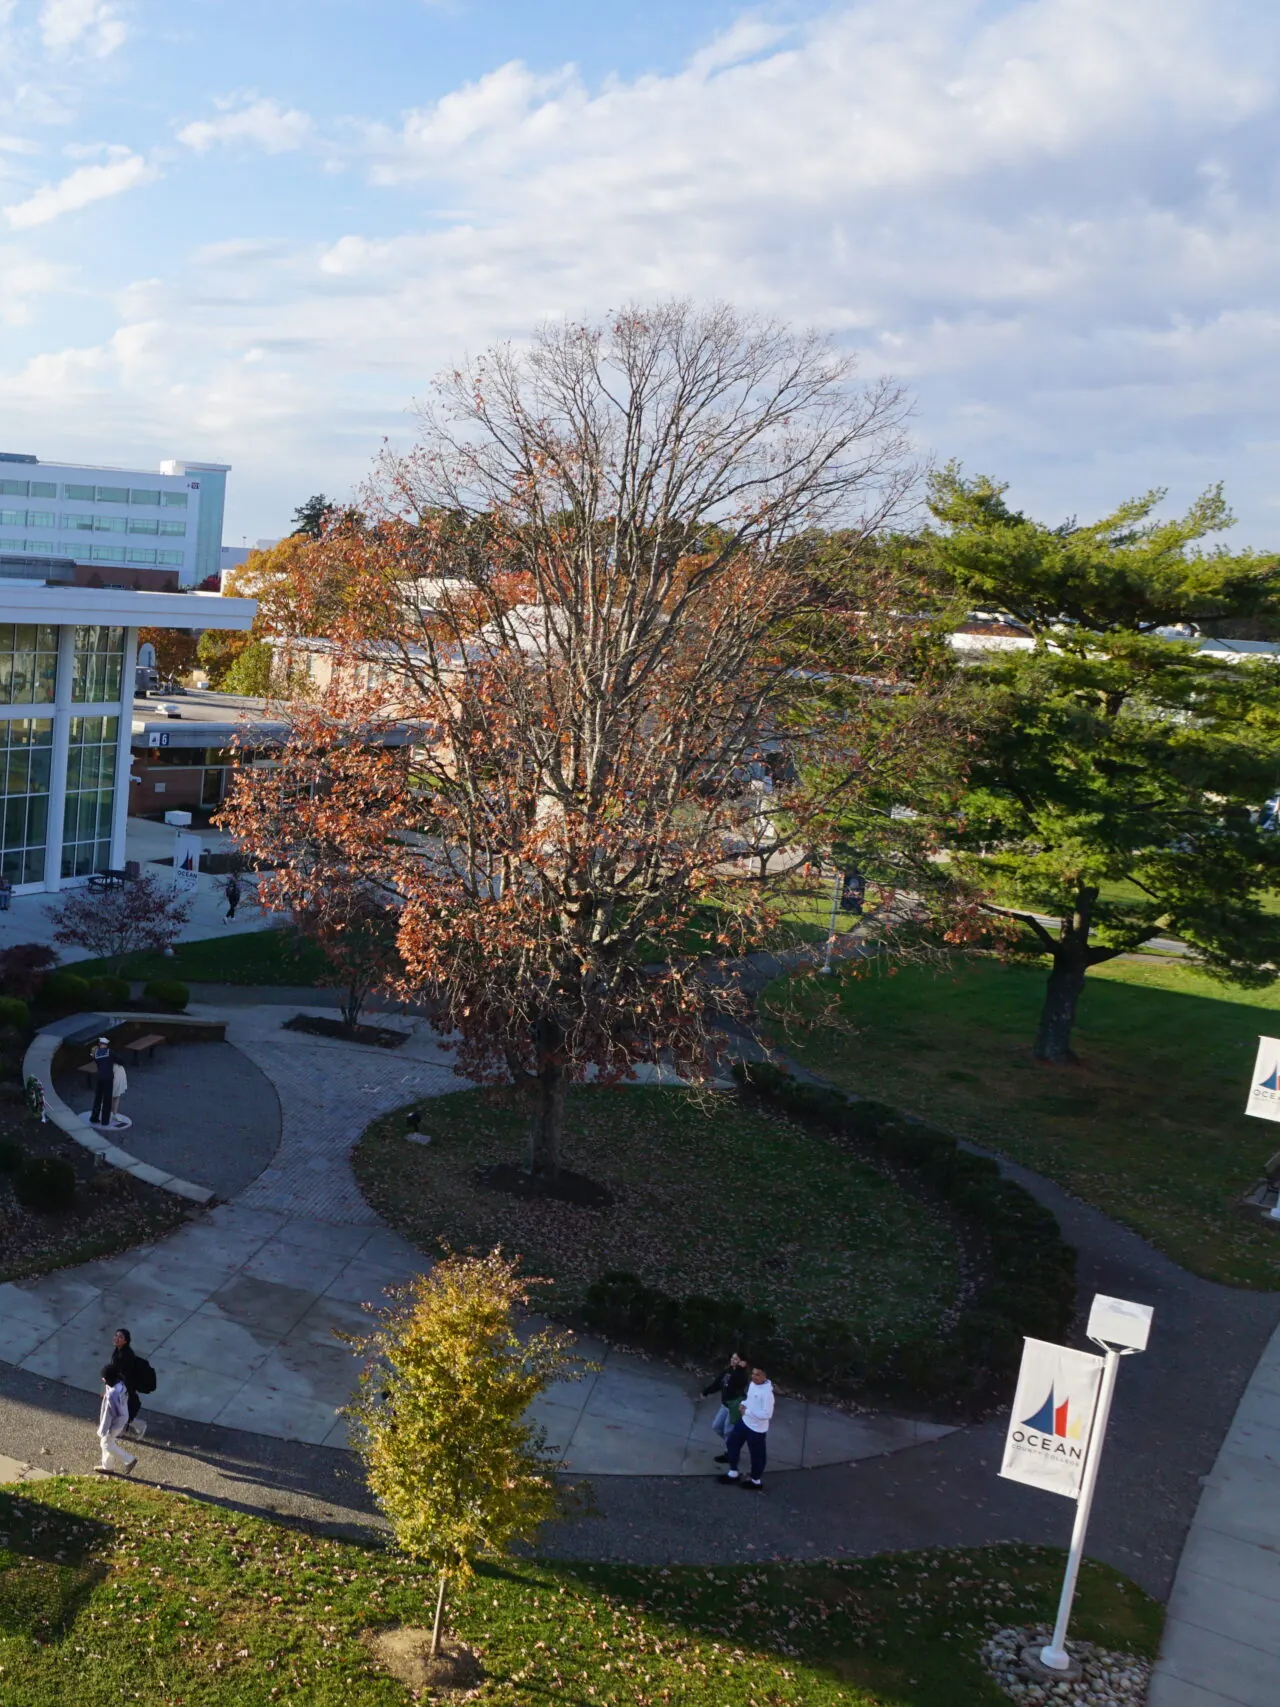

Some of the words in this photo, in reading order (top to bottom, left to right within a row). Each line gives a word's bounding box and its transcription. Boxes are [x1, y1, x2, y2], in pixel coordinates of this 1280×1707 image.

[161, 734, 168, 745] 6
[177, 870, 198, 879] OCEAN
[1254, 1089, 1280, 1100] OCE
[1012, 1430, 1082, 1460] OCEAN
